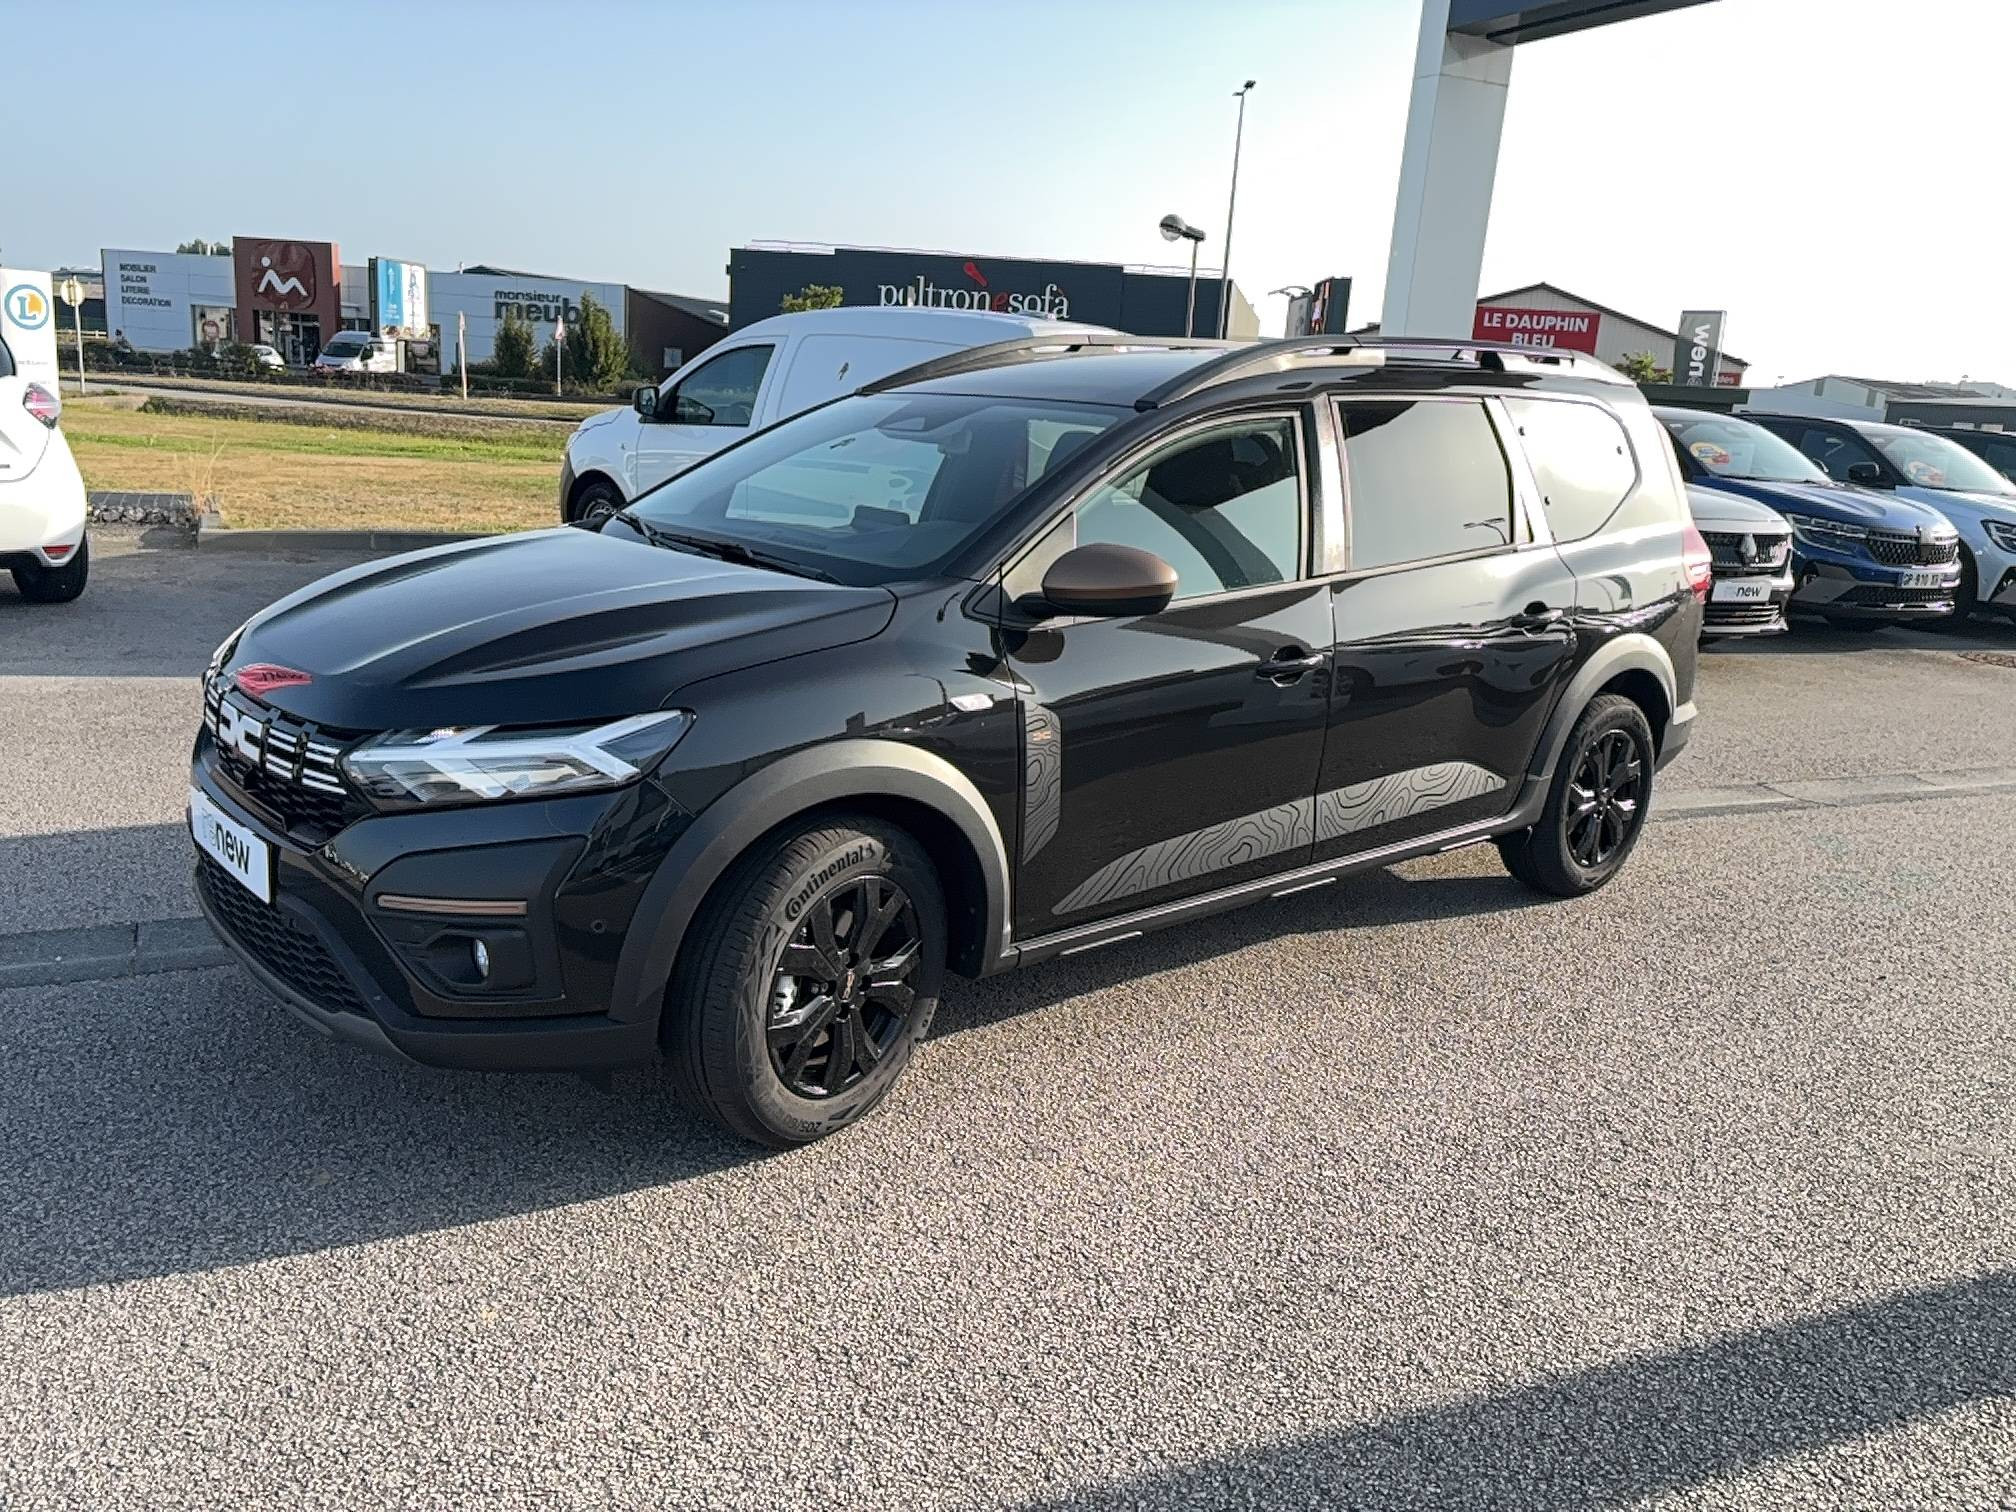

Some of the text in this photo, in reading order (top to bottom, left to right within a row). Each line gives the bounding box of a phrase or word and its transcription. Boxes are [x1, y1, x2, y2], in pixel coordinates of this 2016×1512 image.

[121, 274, 147, 283] SALON
[494, 289, 561, 303] monsieur
[495, 297, 583, 324] meub
[1483, 311, 1590, 333] LE DAUPHIN
[1511, 332, 1556, 348] BLEU
[784, 844, 865, 922] Continental
